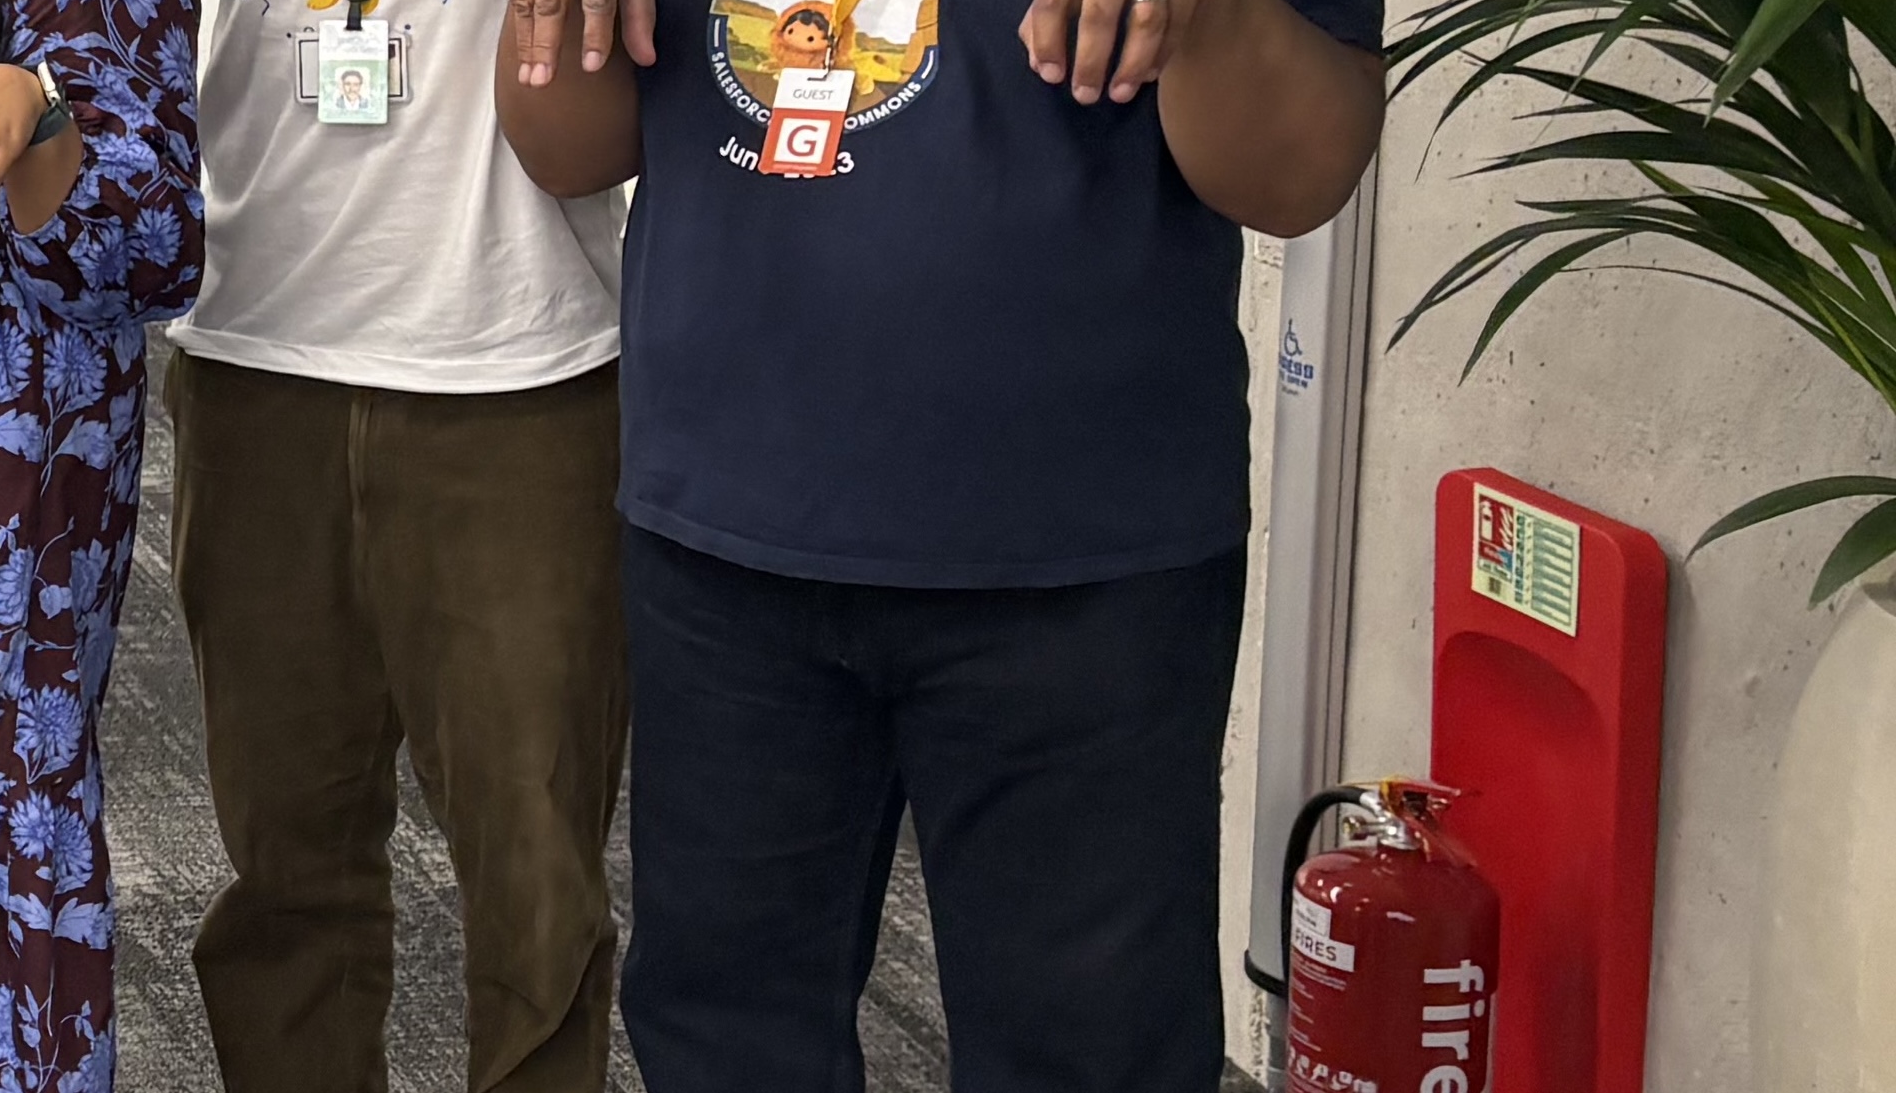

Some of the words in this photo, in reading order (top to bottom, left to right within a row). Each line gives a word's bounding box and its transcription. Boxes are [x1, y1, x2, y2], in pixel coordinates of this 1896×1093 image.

[711, 51, 773, 126] SALESFORC
[844, 81, 922, 131] OMMONS
[793, 88, 835, 100] GUEST
[719, 136, 759, 171] Jun
[787, 125, 819, 156] G
[1295, 928, 1337, 962] FIRES
